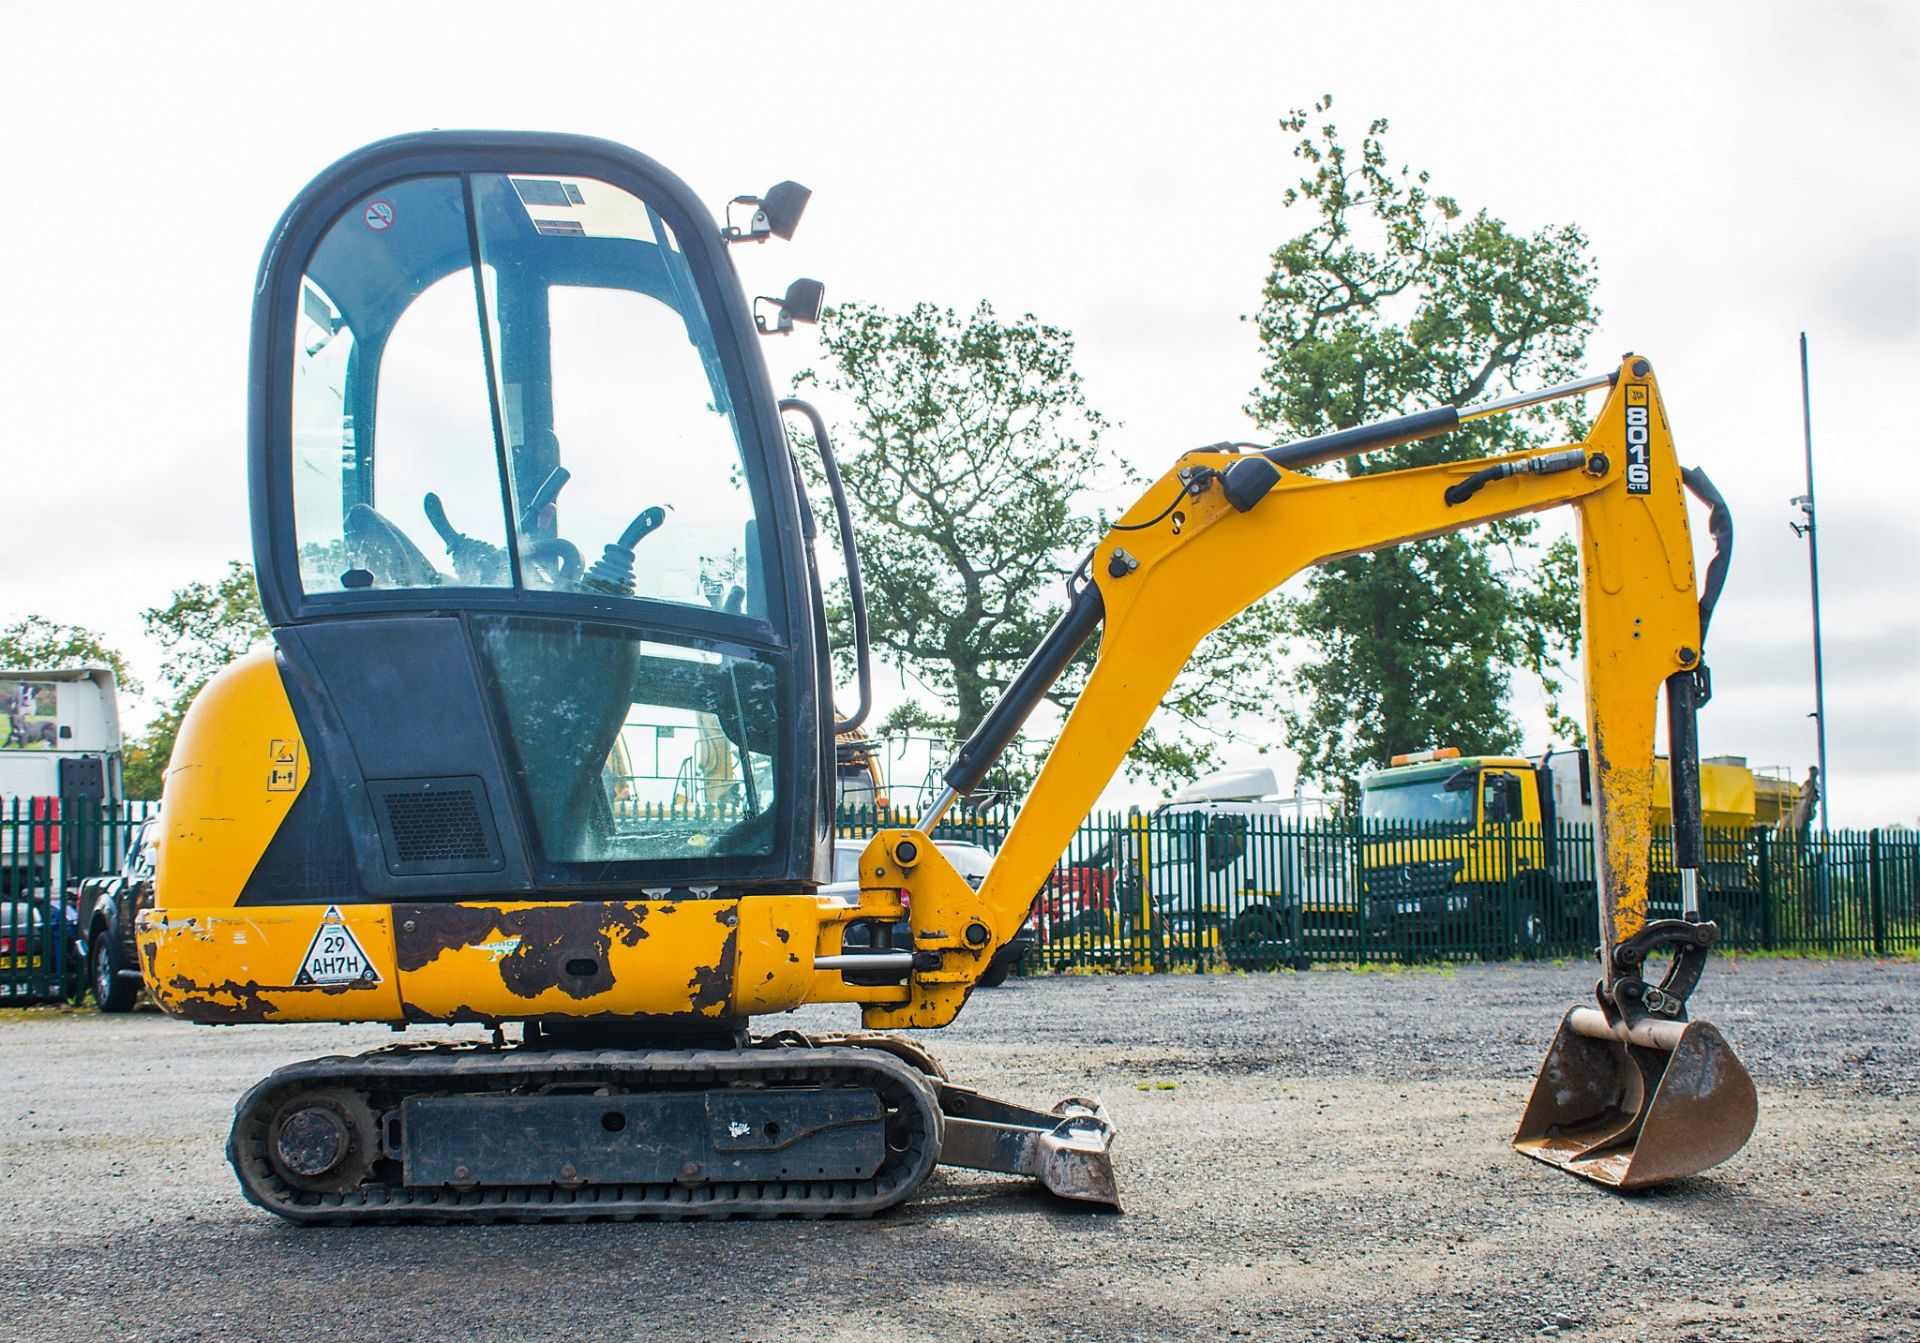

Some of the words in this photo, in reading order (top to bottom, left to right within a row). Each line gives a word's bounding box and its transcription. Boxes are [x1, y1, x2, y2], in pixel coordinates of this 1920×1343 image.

[1627, 407, 1649, 482] 8016
[323, 936, 345, 953] 29
[312, 956, 359, 975] AH7H
